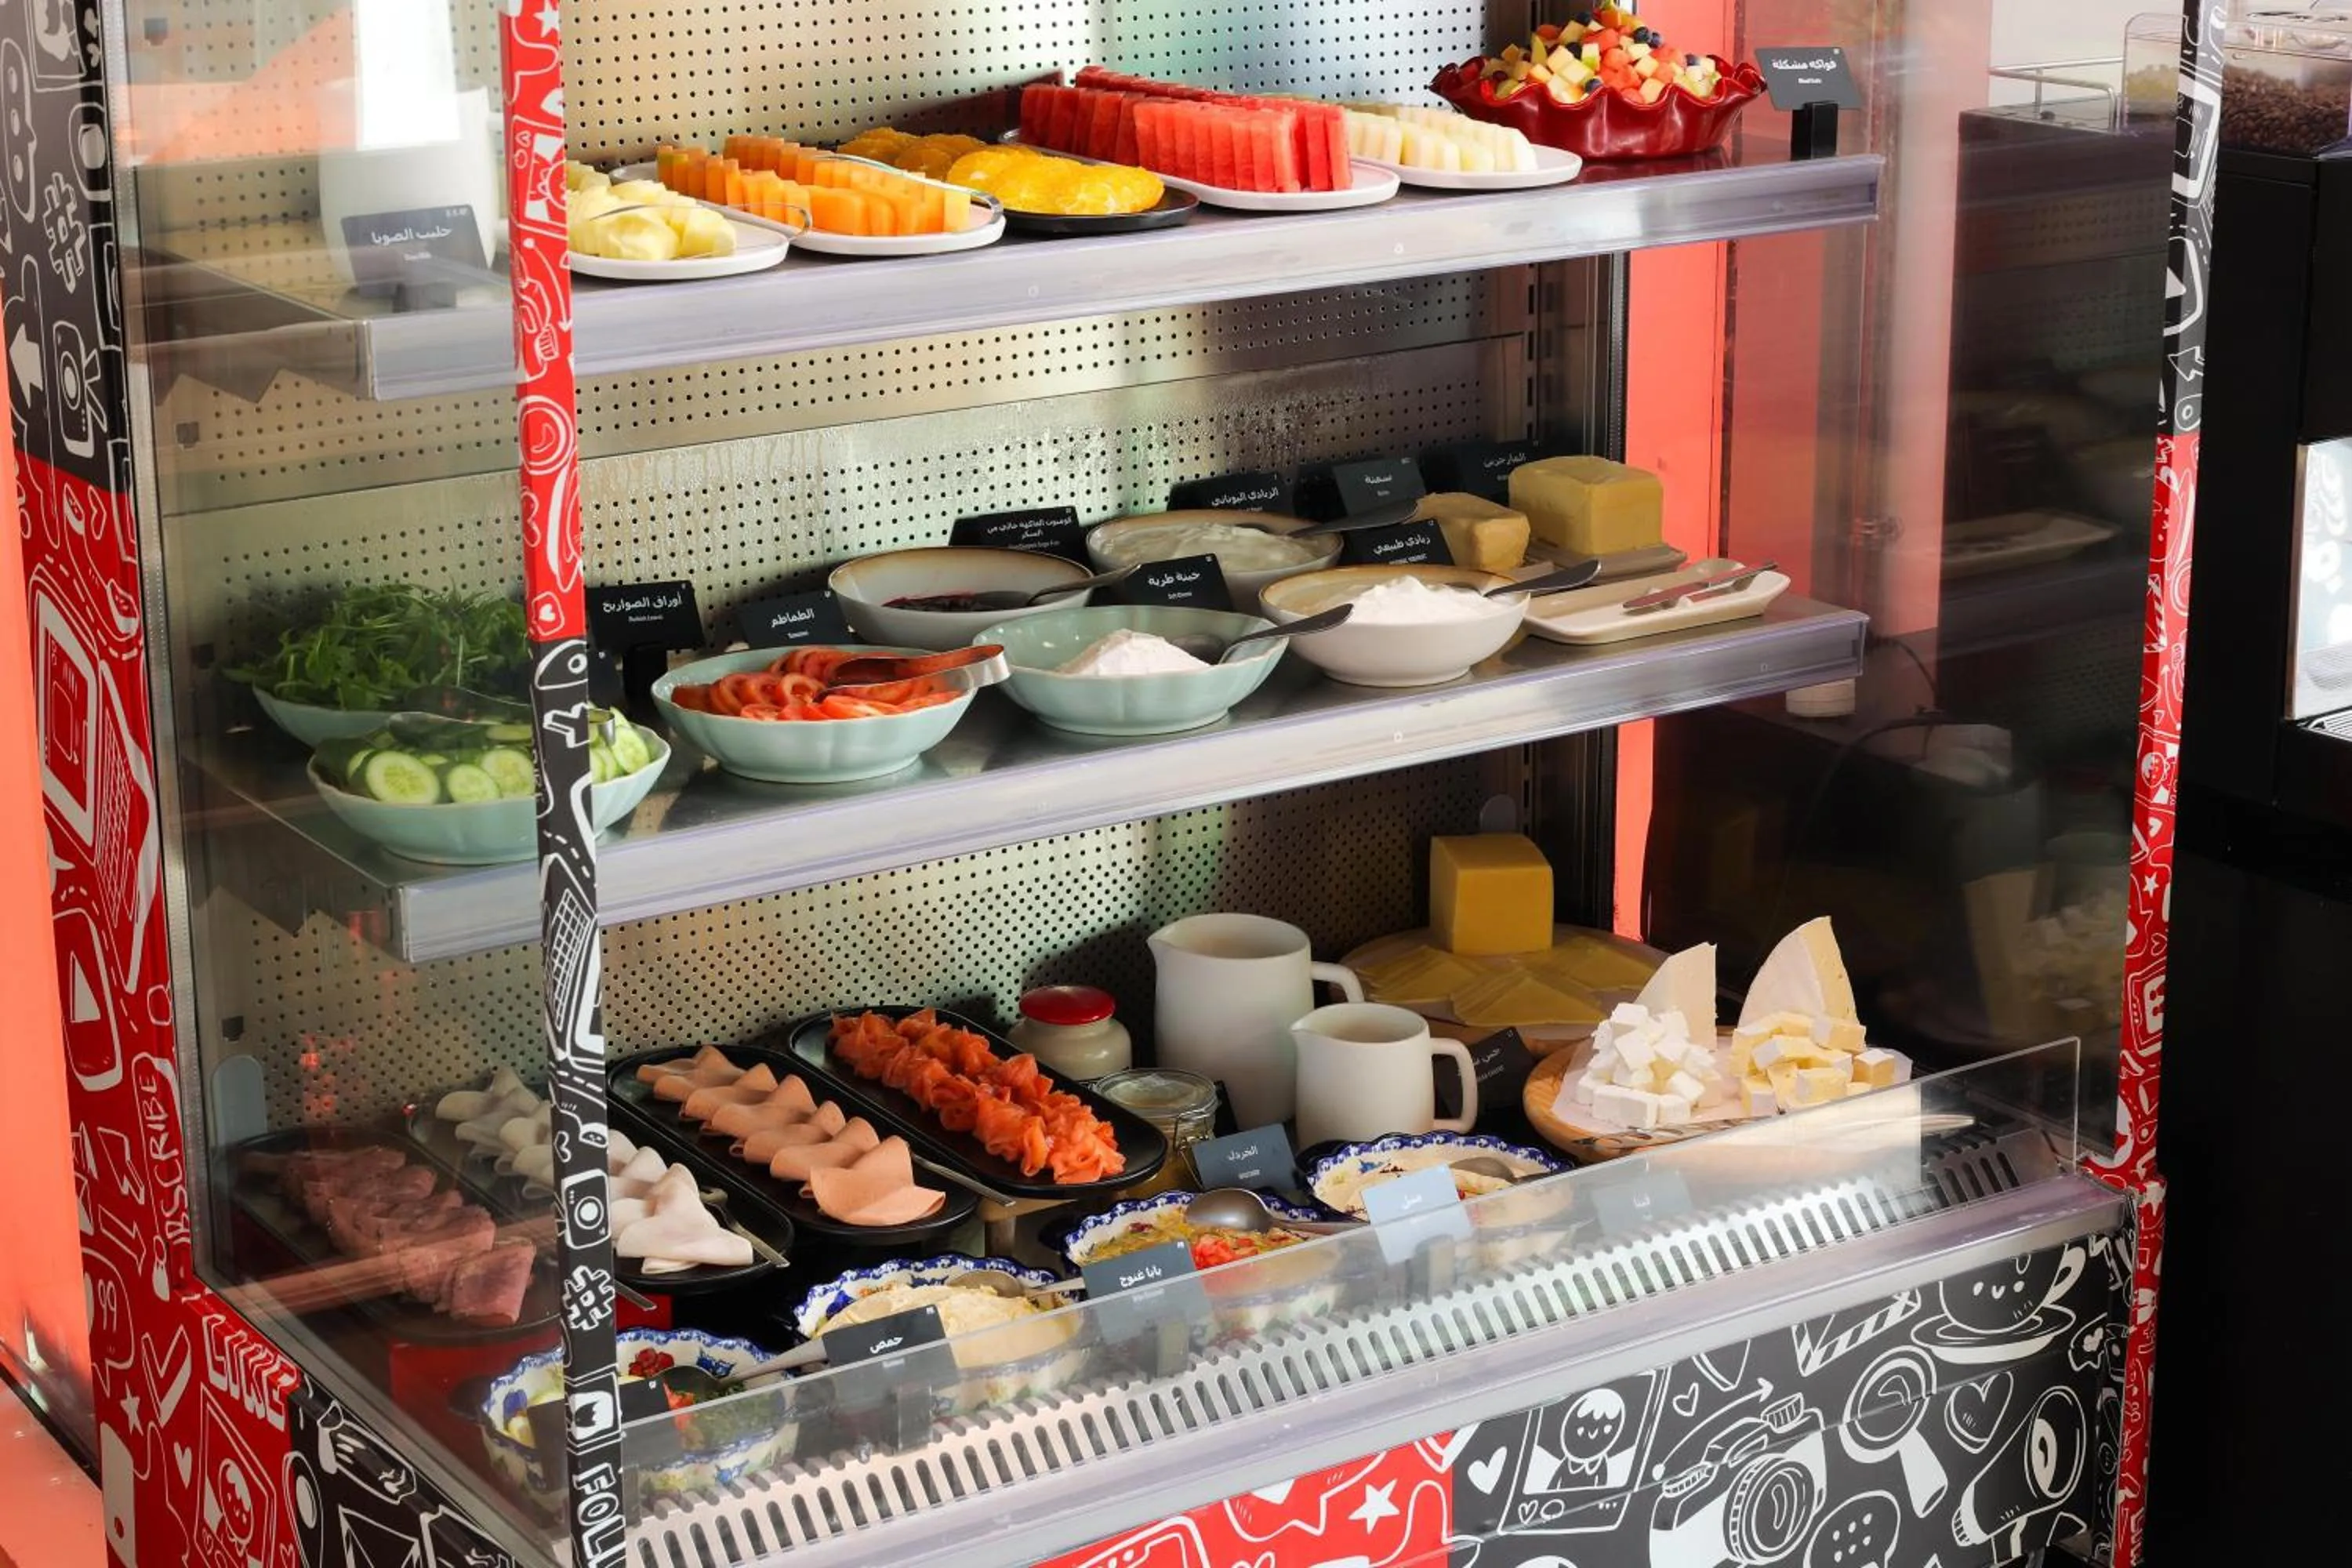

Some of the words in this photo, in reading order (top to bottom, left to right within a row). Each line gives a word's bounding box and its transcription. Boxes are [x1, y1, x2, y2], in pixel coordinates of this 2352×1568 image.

[652, 590, 684, 609] أوراق
[770, 608, 815, 629] الطماطم
[1119, 1269, 1145, 1288] غنوج
[1145, 1264, 1162, 1280] بابا
[869, 1336, 904, 1355] حمص
[201, 1313, 298, 1432] LIKE
